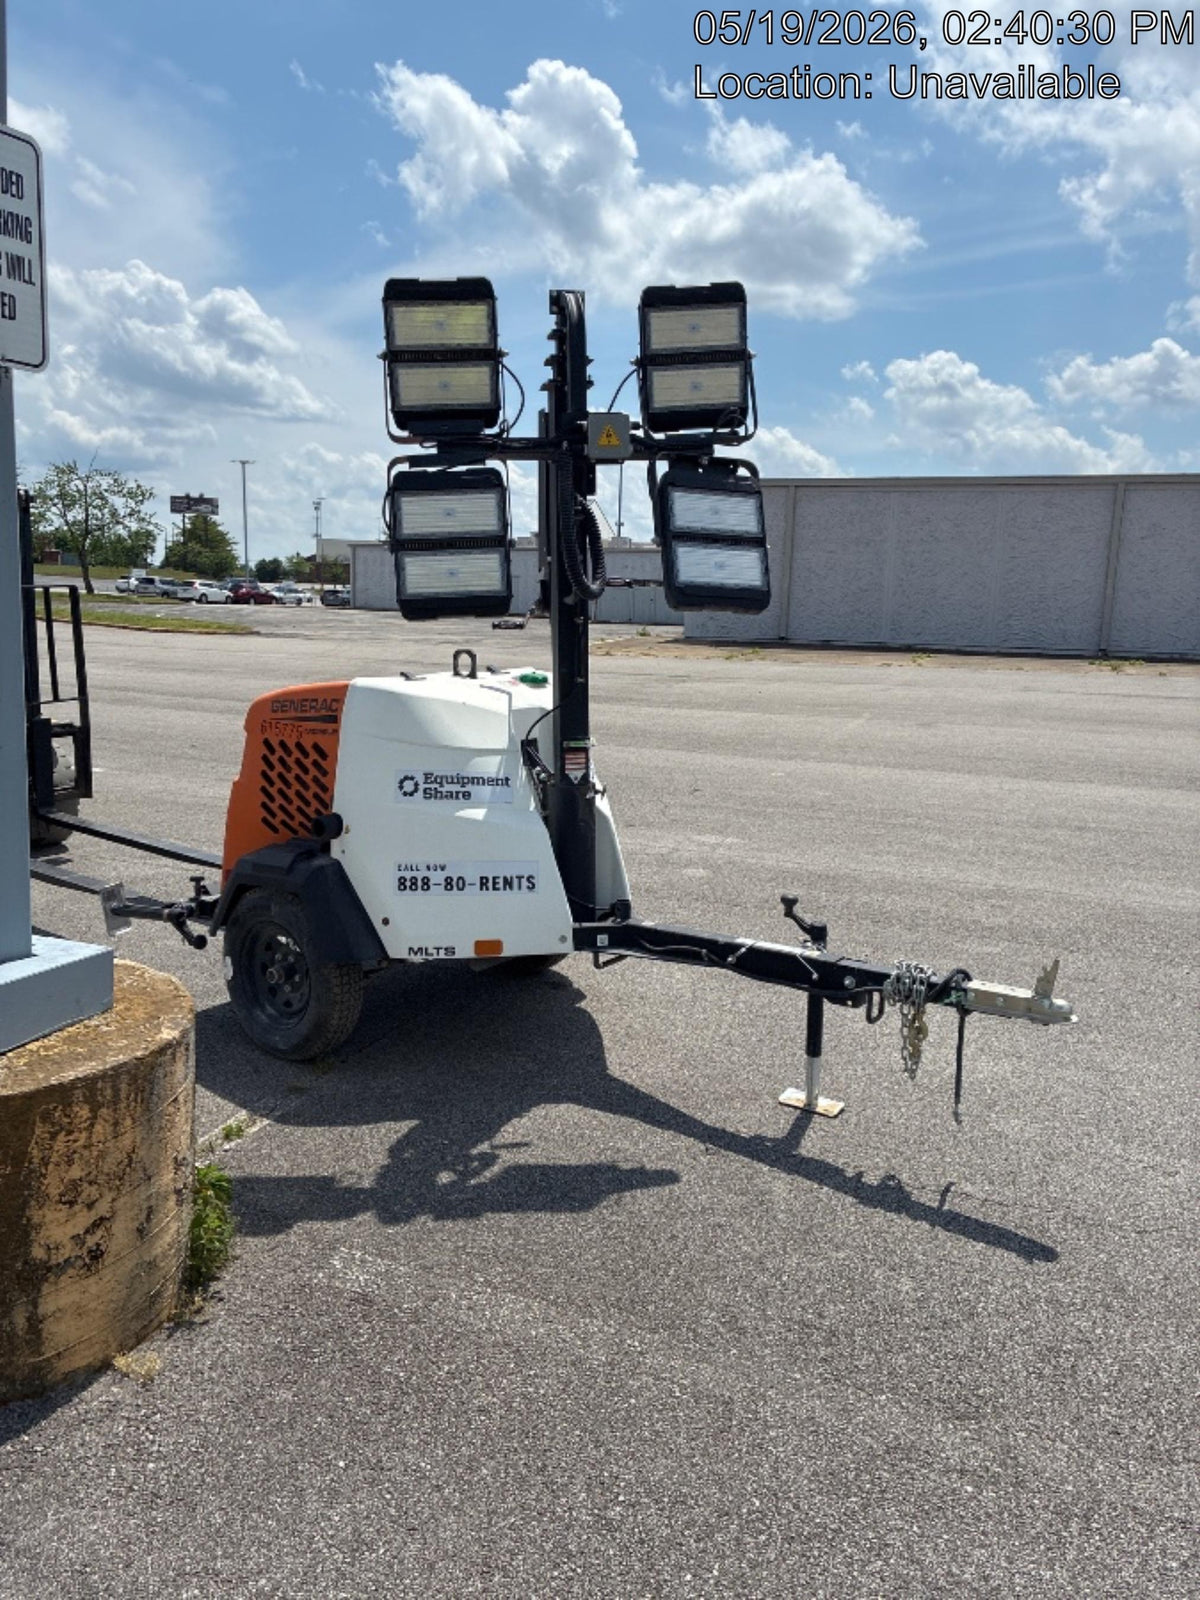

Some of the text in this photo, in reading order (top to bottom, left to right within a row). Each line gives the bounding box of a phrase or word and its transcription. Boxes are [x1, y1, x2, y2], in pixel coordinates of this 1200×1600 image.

[5, 252, 36, 286] WILL
[271, 697, 340, 714] GENERAC
[422, 772, 512, 788] Equipment
[422, 787, 472, 801] Share
[397, 863, 448, 872] CALL NOW
[397, 874, 537, 893] 888-80-RENTS
[408, 946, 456, 957] MLTS
